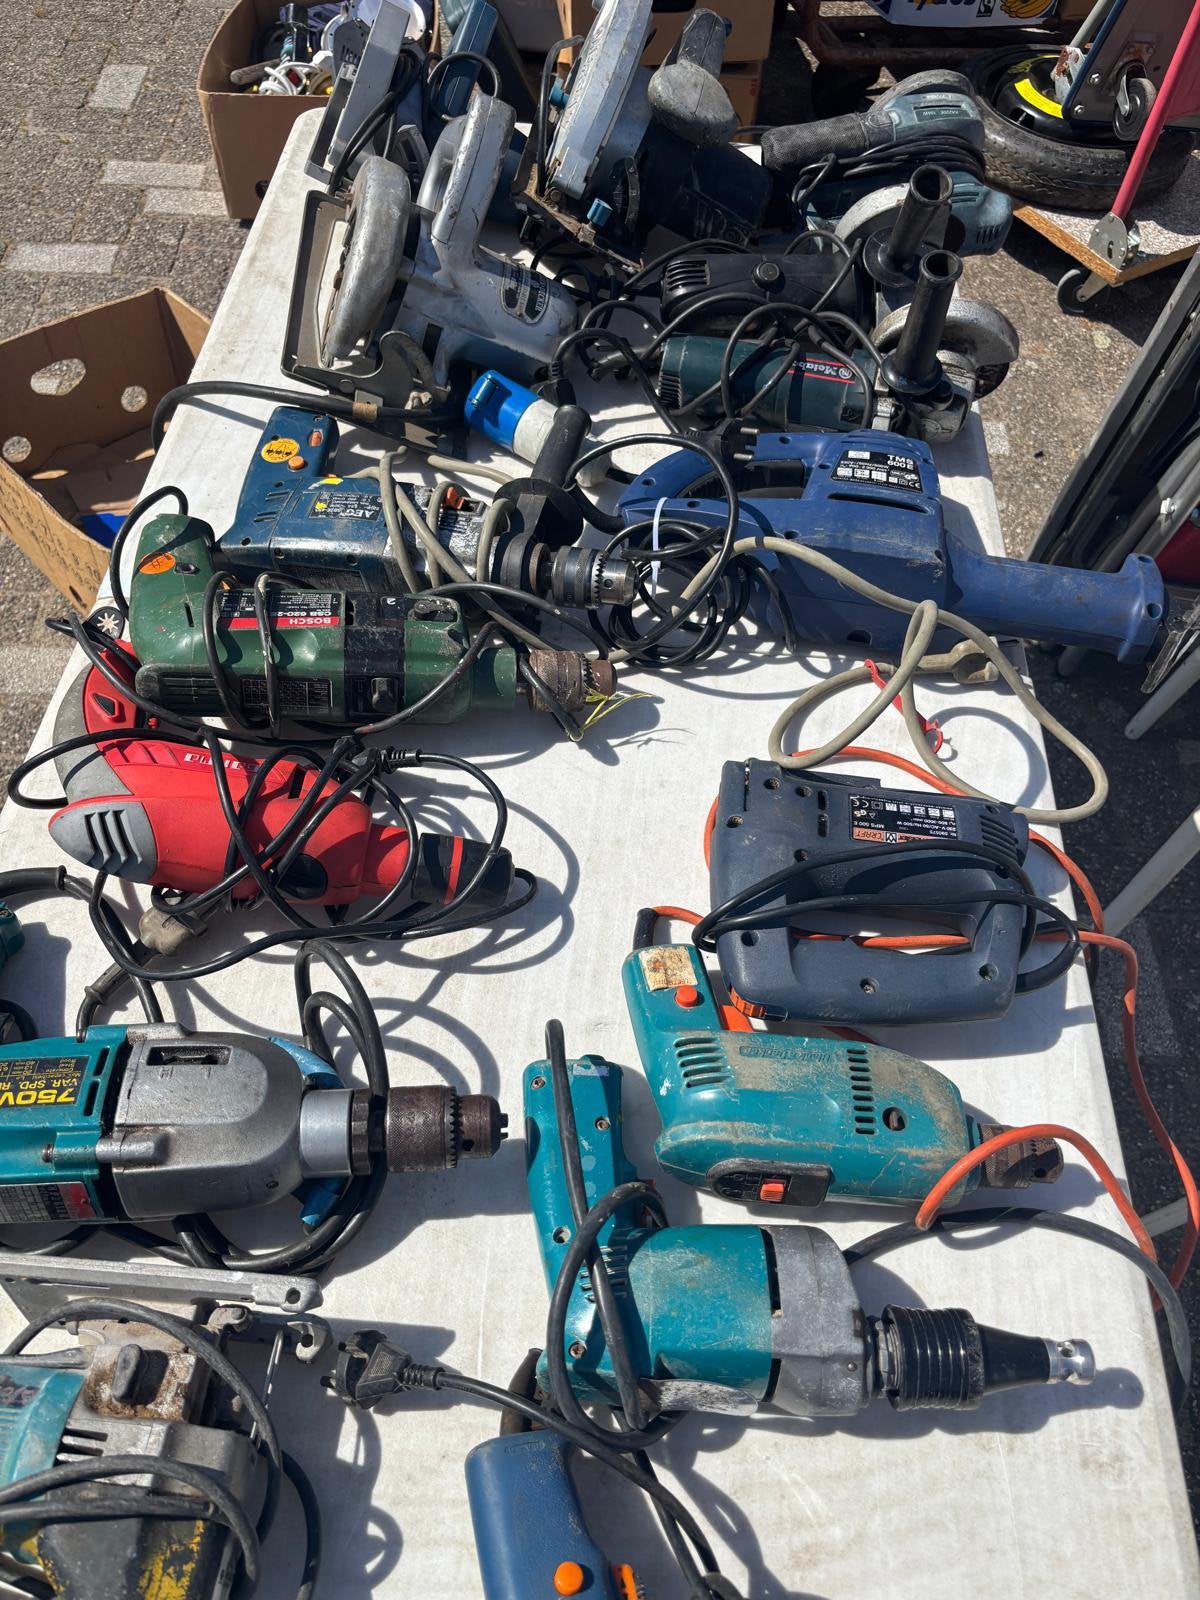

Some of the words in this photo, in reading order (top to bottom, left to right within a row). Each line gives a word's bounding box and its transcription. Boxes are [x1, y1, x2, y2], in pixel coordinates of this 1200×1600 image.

[887, 454, 914, 465] TMS
[887, 459, 906, 468] 600
[289, 617, 332, 625] BOSCH
[854, 829, 882, 840] CRAFT
[19, 1080, 46, 1090] SPD.
[51, 1078, 78, 1088] VAR.
